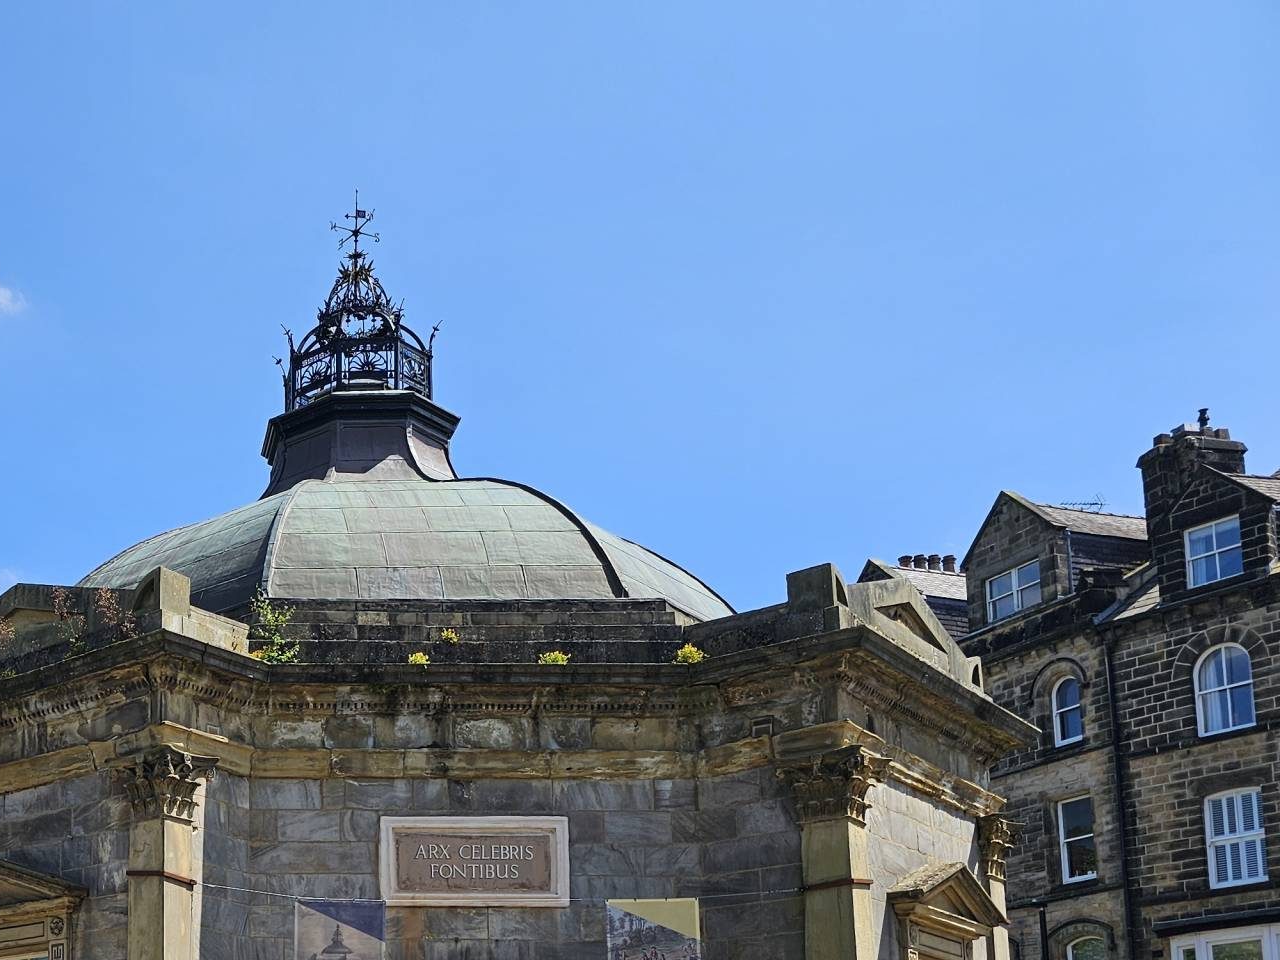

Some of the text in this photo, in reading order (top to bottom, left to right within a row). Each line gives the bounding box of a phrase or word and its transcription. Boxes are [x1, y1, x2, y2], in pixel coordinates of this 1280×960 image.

[415, 844, 535, 860] ARX CELEBRIS
[430, 863, 520, 879] FONTIBUS
